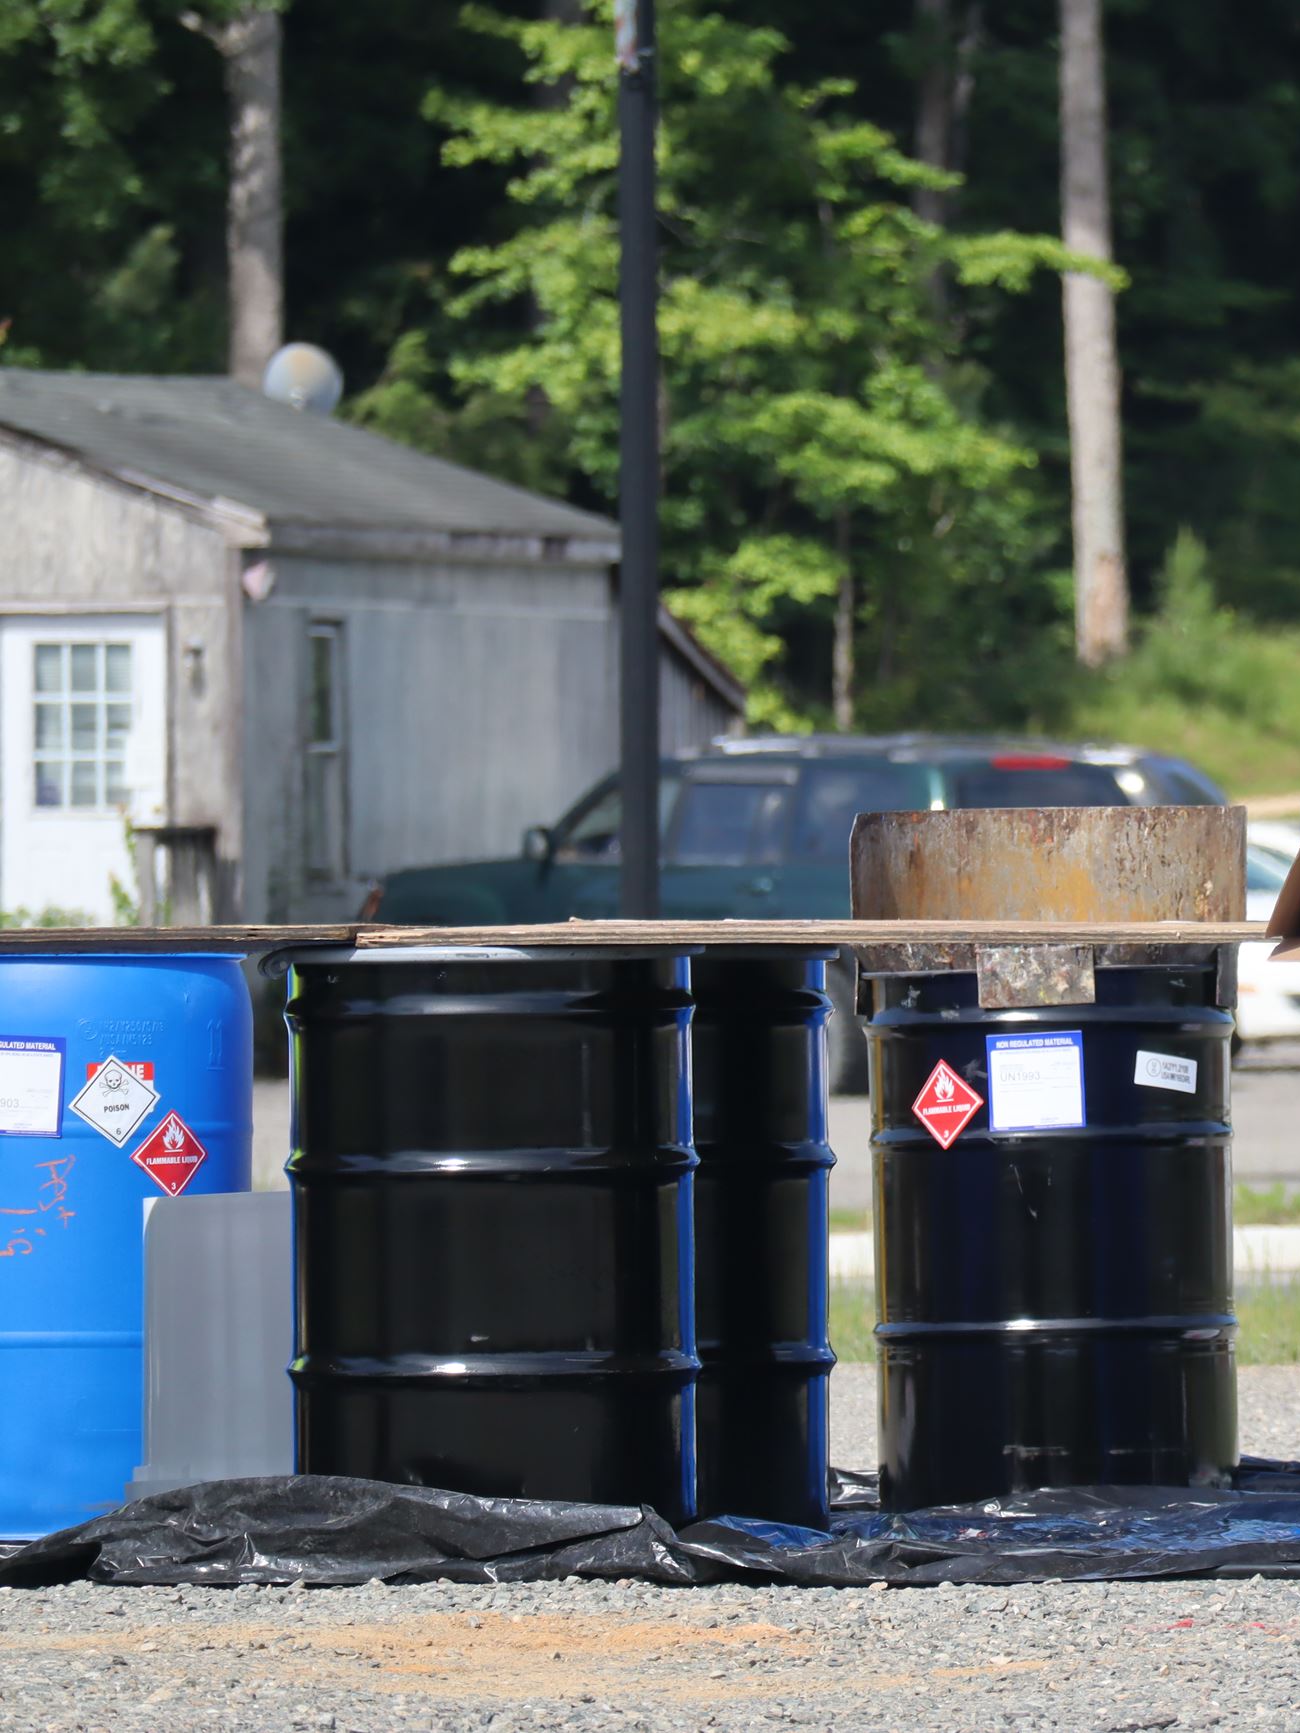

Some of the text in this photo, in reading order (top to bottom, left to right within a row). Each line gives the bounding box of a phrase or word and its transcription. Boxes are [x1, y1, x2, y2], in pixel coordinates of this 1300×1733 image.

[25, 1042, 56, 1051] MATERIAL
[996, 1037, 1073, 1048] NON REGULATED MATERIAL
[1000, 1071, 1041, 1082] UN1993
[104, 1104, 129, 1113] POISON
[922, 1104, 971, 1116] FLAMMABLE LIQUID
[116, 1127, 121, 1135] 6
[943, 1129, 949, 1138] 3
[146, 1155, 198, 1165] FLAMMABLE LIQUID
[171, 1182, 176, 1190] 3
